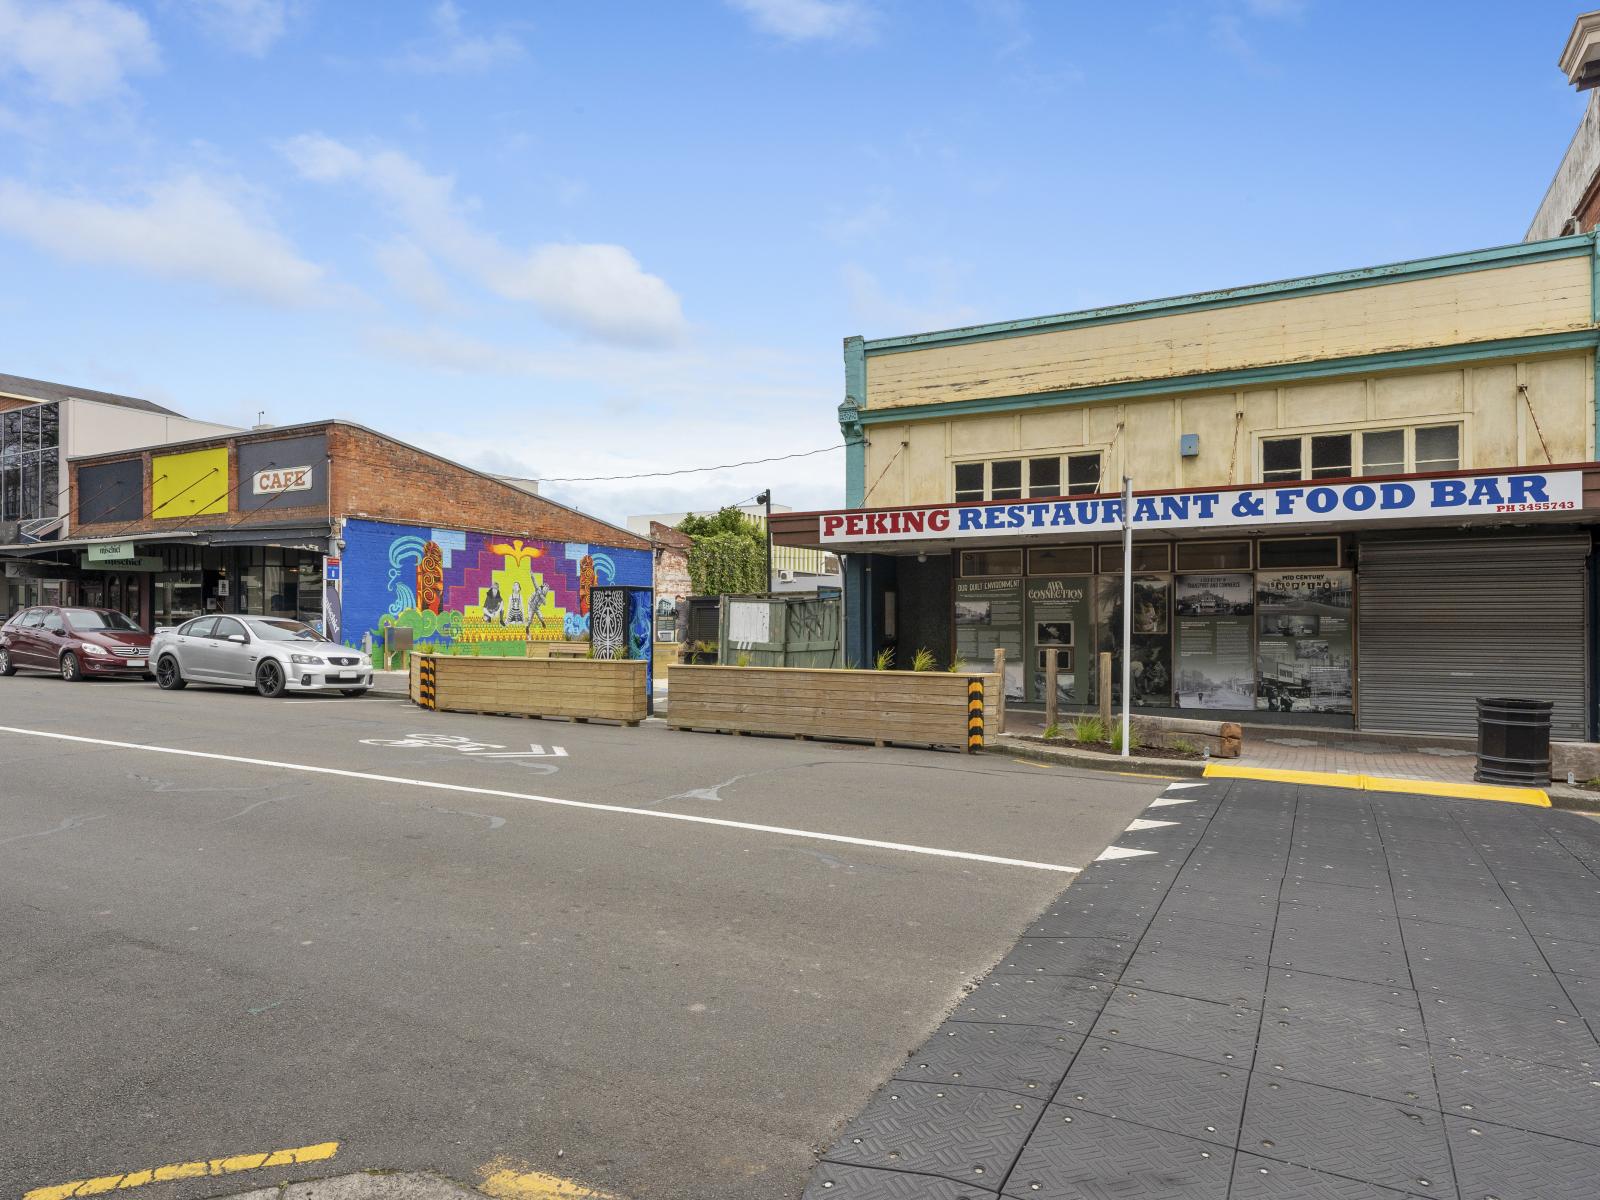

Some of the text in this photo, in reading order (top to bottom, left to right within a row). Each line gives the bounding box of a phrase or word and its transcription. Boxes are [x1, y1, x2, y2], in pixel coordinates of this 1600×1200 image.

[259, 470, 306, 491] CAFE
[823, 474, 1550, 537] PEKING RESTAURANT & FOOD BAR
[1496, 501, 1575, 513] PH 3455743
[1028, 589, 1083, 600] CONNECTION
